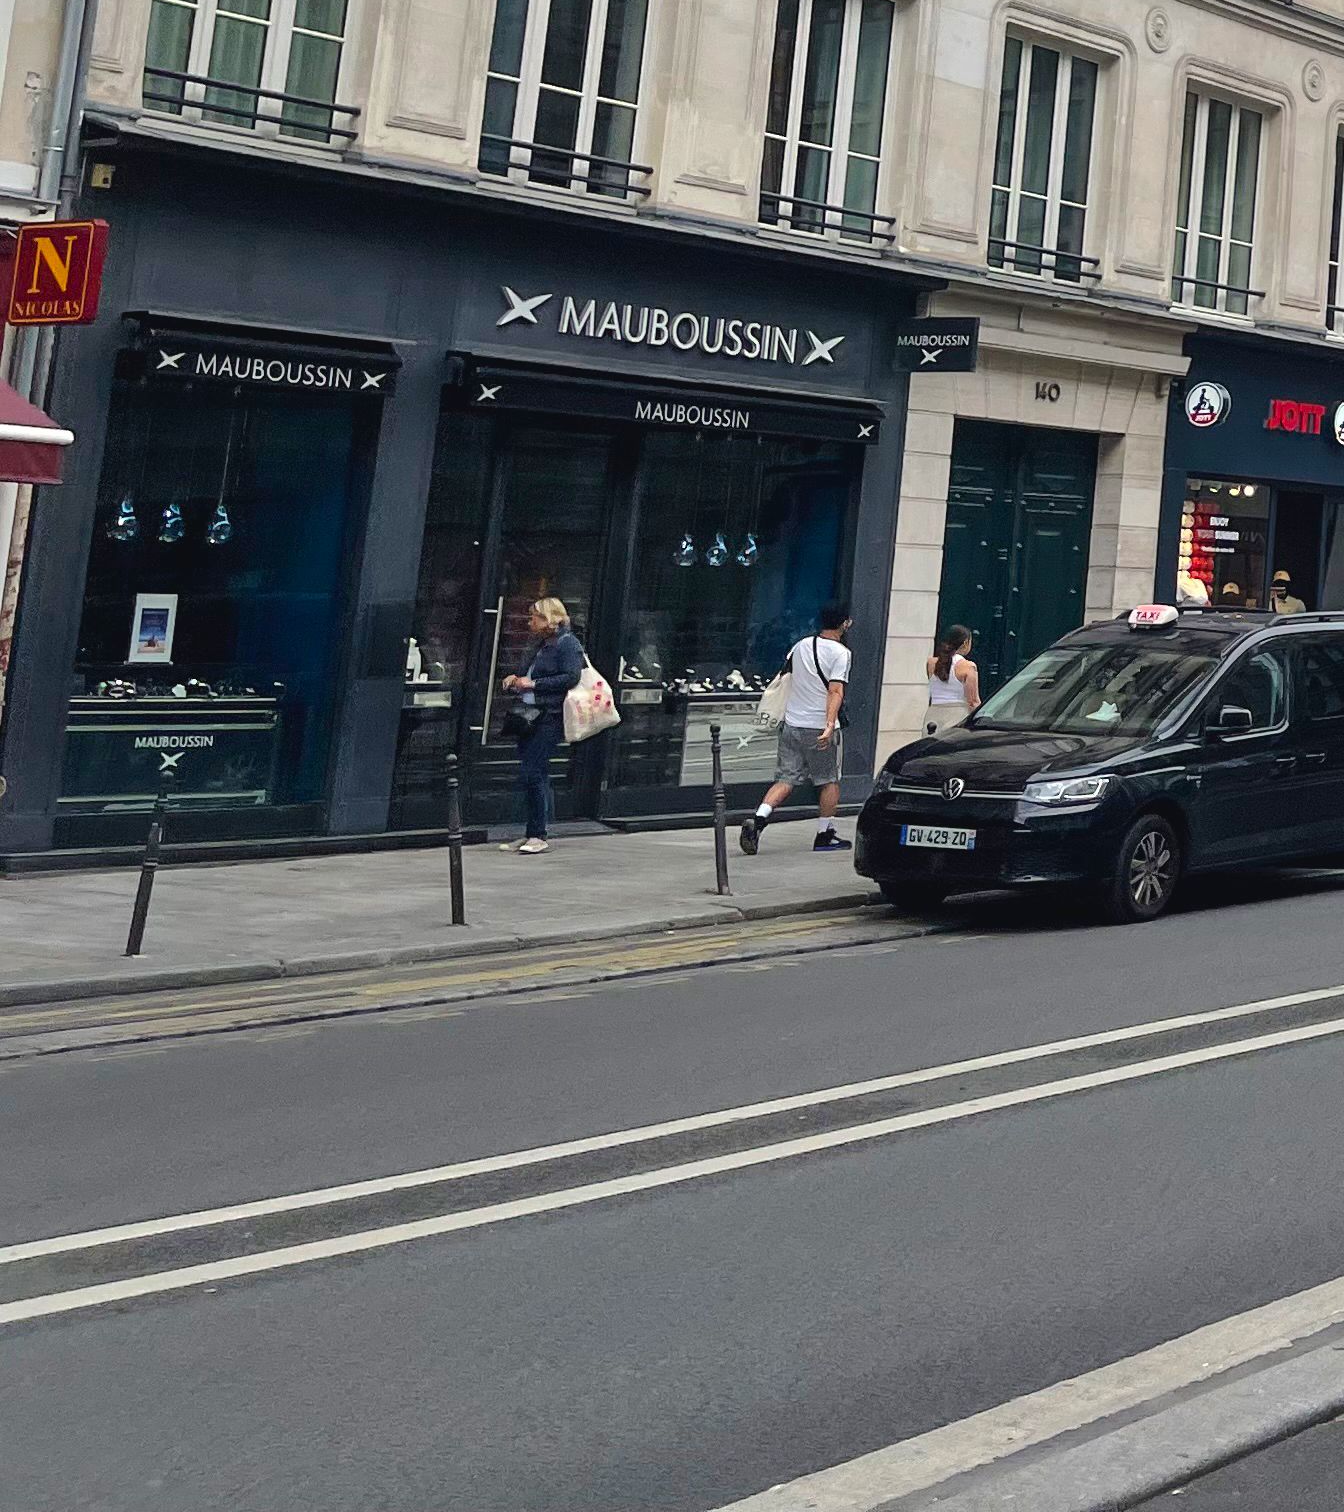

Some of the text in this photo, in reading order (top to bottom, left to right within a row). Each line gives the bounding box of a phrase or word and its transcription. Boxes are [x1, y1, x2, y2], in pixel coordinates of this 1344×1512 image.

[27, 235, 77, 293] N
[16, 300, 80, 316] NICOLAS
[557, 296, 798, 364] MAUBOUSSIN
[897, 335, 970, 347] MAUBOUSSIN
[195, 352, 352, 388] MAUBOUSSIN
[1034, 381, 1061, 402] 140
[635, 401, 750, 429] MAUBOUSSIN
[1265, 399, 1326, 435] JOTT
[1136, 611, 1161, 620] TAXI
[134, 735, 214, 749] MAUBOUSSIN
